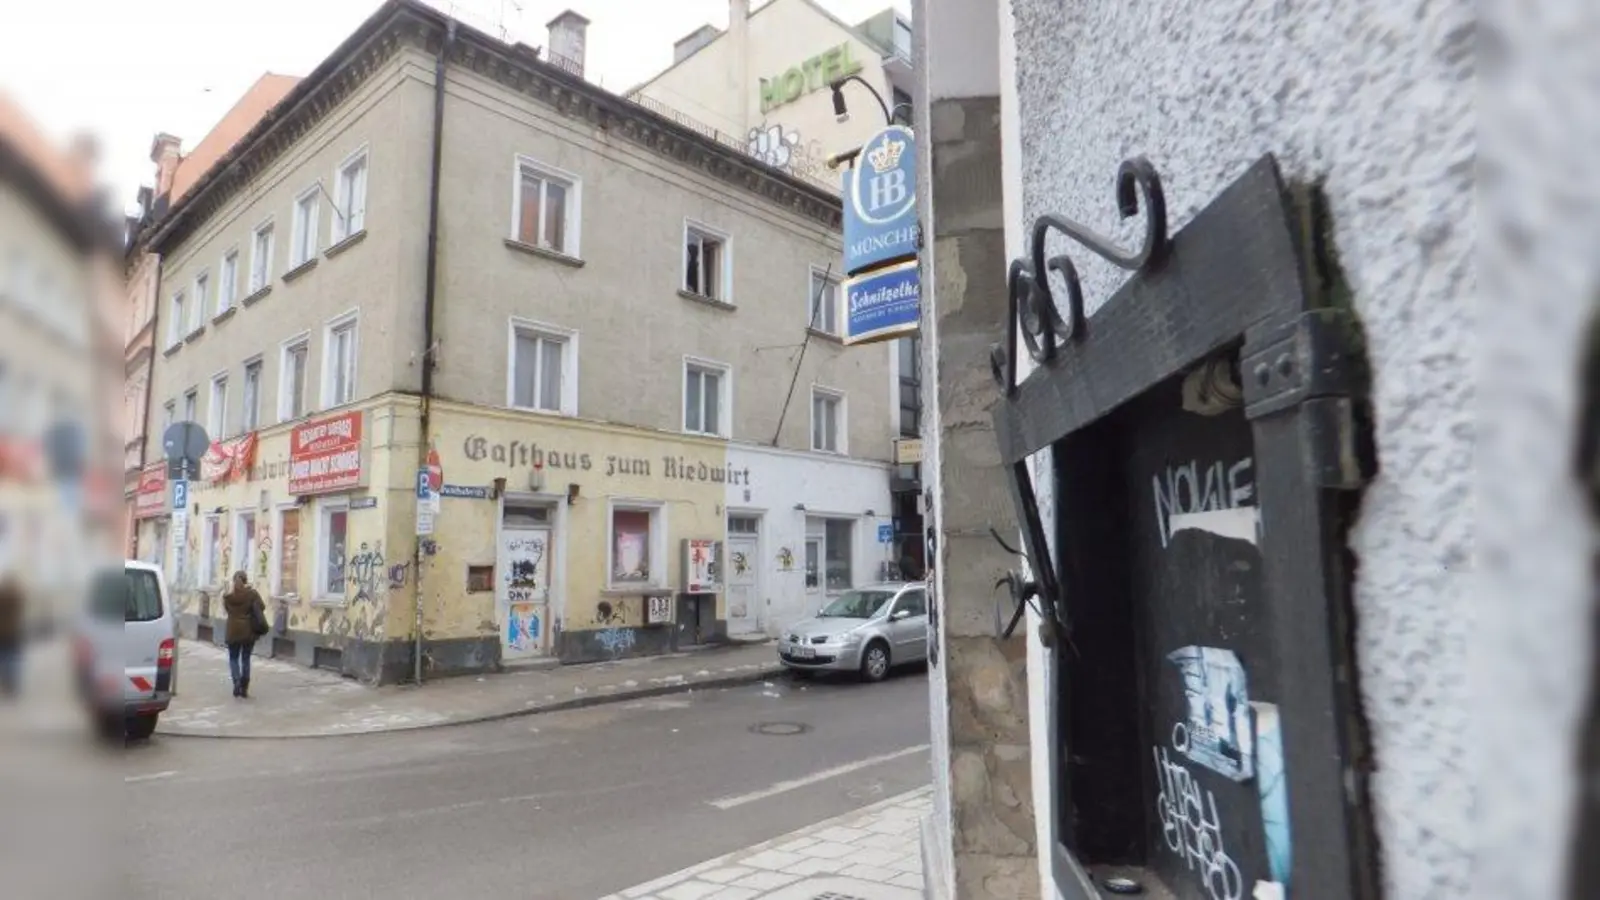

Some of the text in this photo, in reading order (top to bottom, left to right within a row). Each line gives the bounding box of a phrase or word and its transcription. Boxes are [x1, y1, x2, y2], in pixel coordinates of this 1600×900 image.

[759, 40, 864, 115] HOTEL
[869, 167, 906, 212] HB
[849, 224, 919, 261] MÜNCHE
[463, 434, 751, 486] Gasthaus zum Riedwirt
